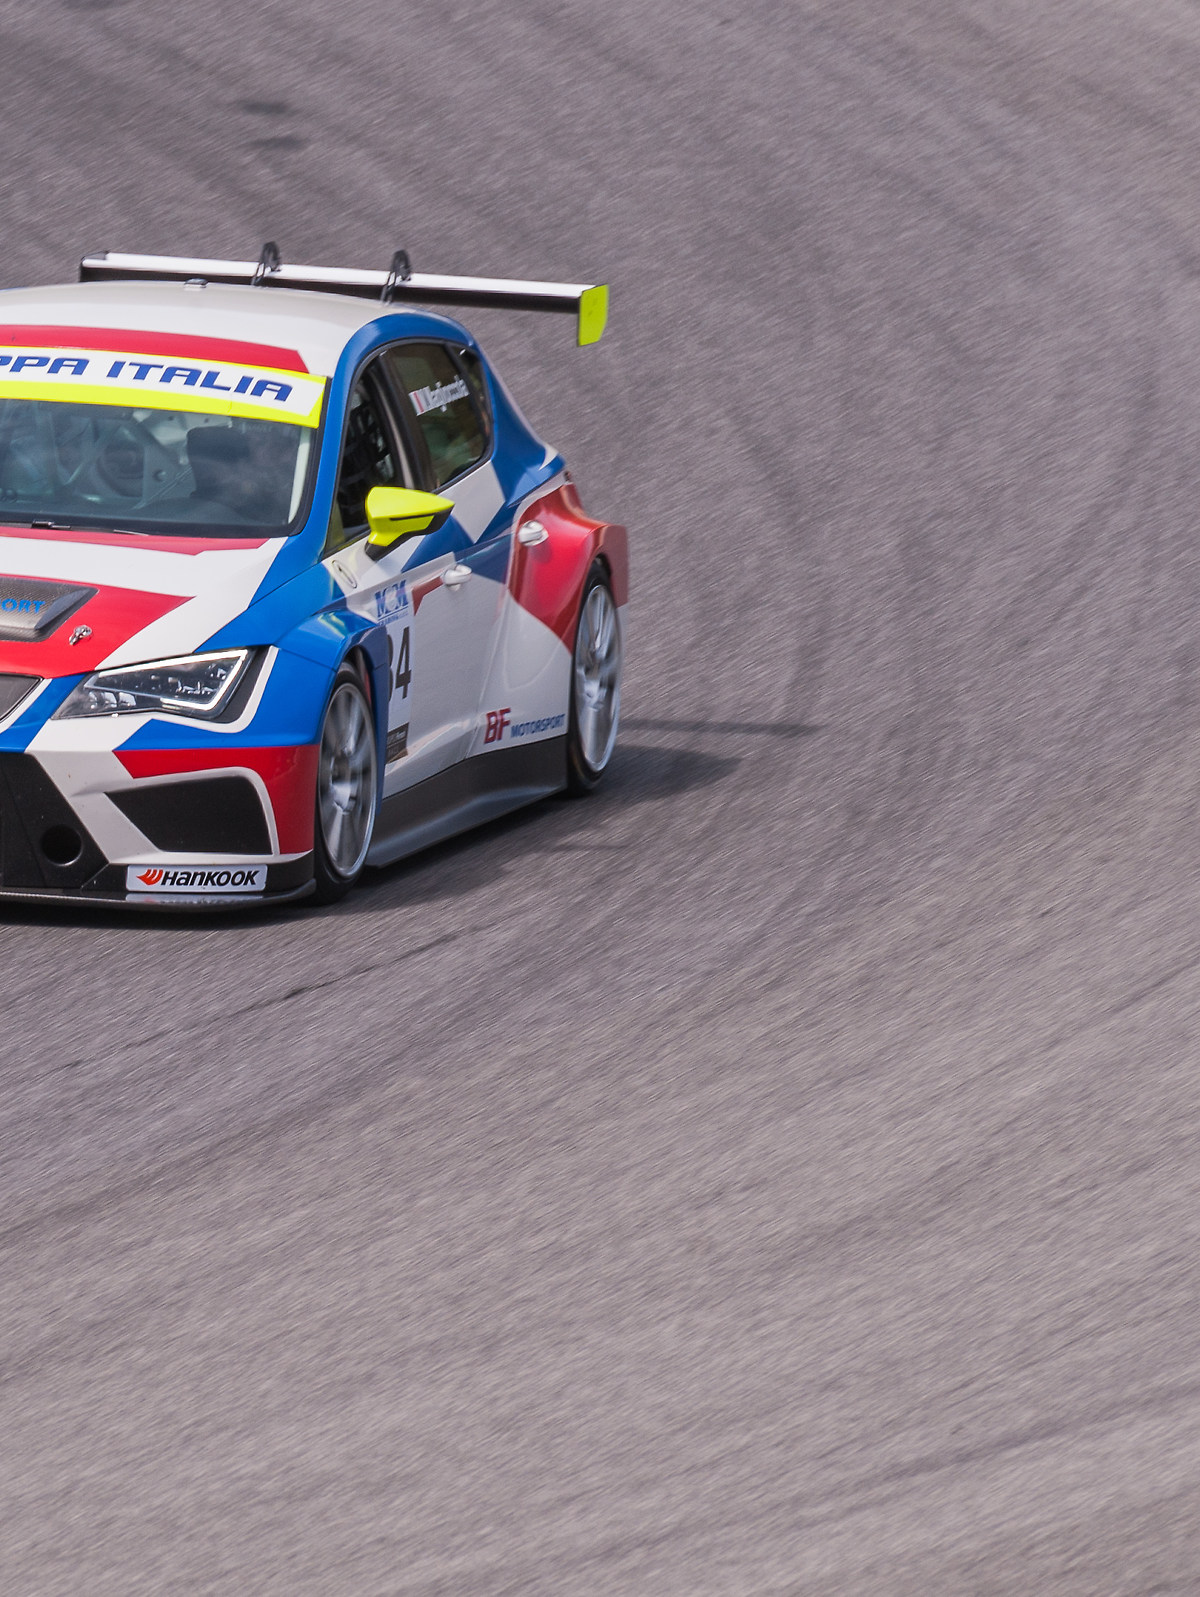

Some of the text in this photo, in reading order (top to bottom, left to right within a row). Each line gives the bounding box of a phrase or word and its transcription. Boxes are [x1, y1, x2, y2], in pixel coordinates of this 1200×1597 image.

[105, 360, 294, 403] ITALIA
[483, 707, 566, 744] BF MOTORSPORT
